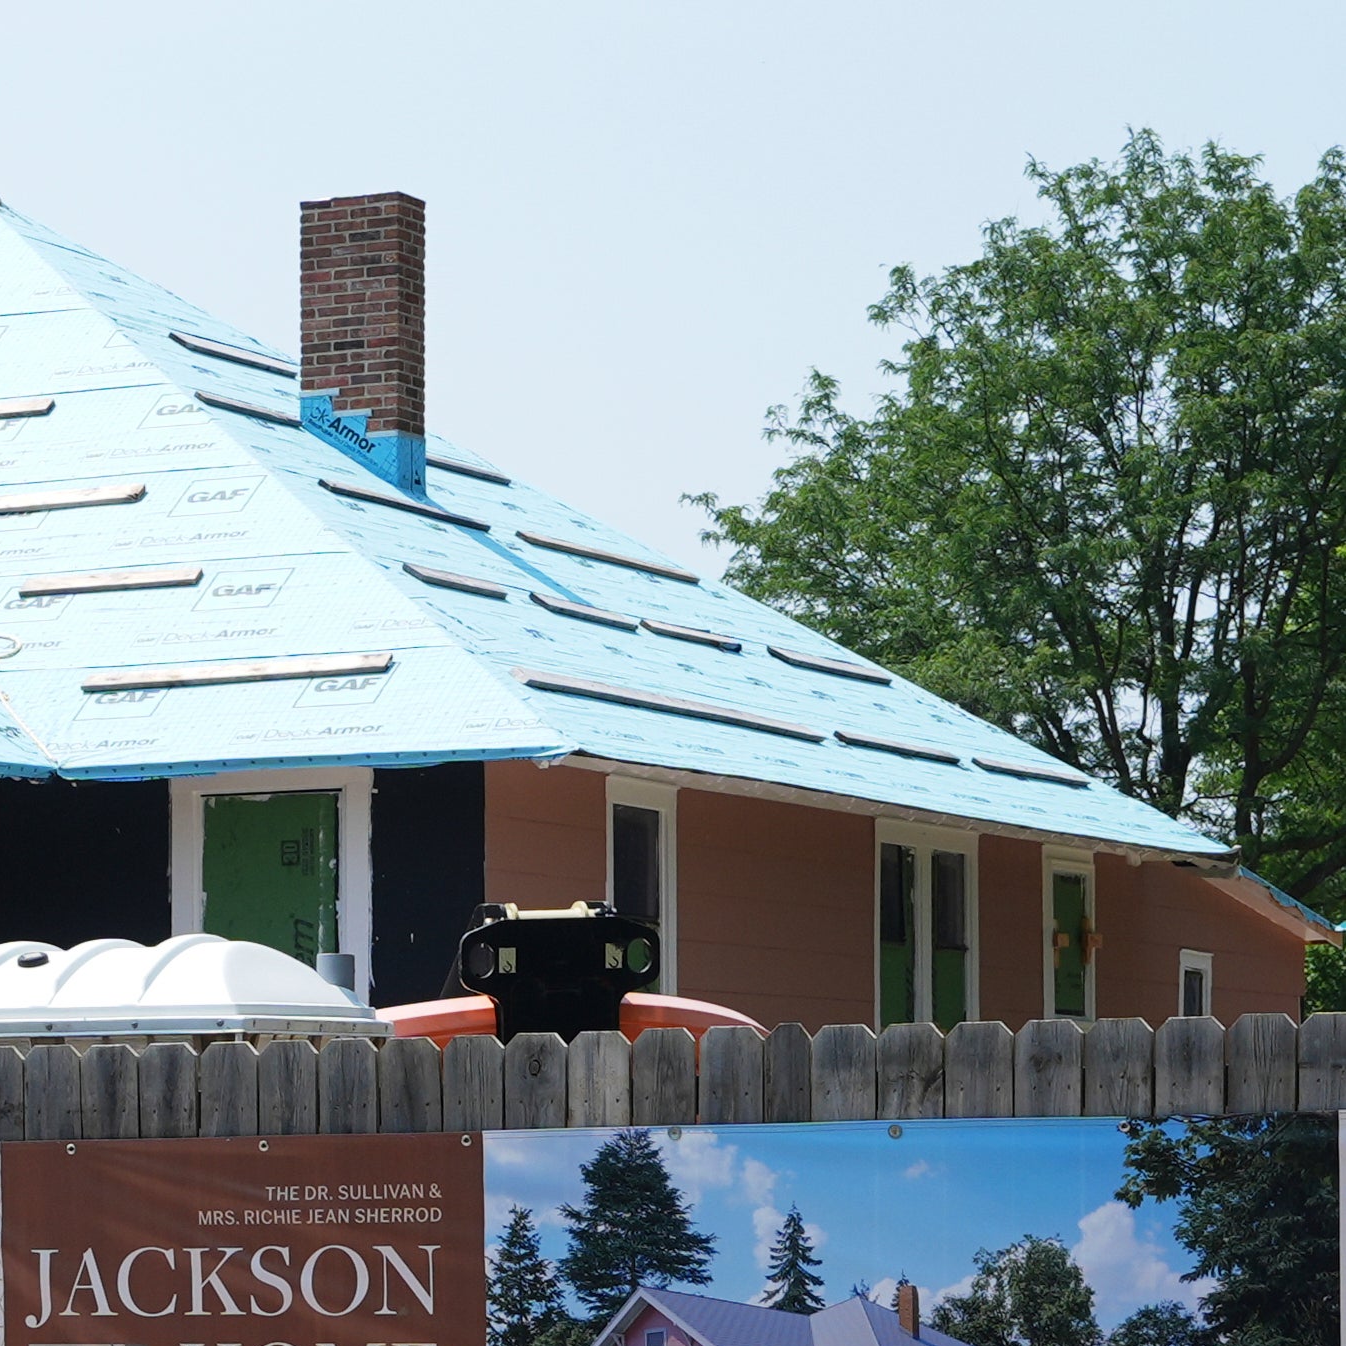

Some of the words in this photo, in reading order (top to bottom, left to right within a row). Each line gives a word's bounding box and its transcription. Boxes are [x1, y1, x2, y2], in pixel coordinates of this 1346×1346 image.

[186, 487, 251, 503] GAF
[212, 583, 279, 598] GAF
[313, 676, 381, 693] GAF
[265, 1185, 300, 1202] THE
[305, 1185, 333, 1202] DR.
[337, 1184, 426, 1201] SULLIVAN
[427, 1184, 442, 1200] &
[198, 1209, 239, 1226] MRS.
[243, 1208, 302, 1225] RICHIE
[306, 1208, 351, 1225] JEAN
[354, 1206, 442, 1224] SHERROD
[25, 1244, 441, 1329] JACKSON
